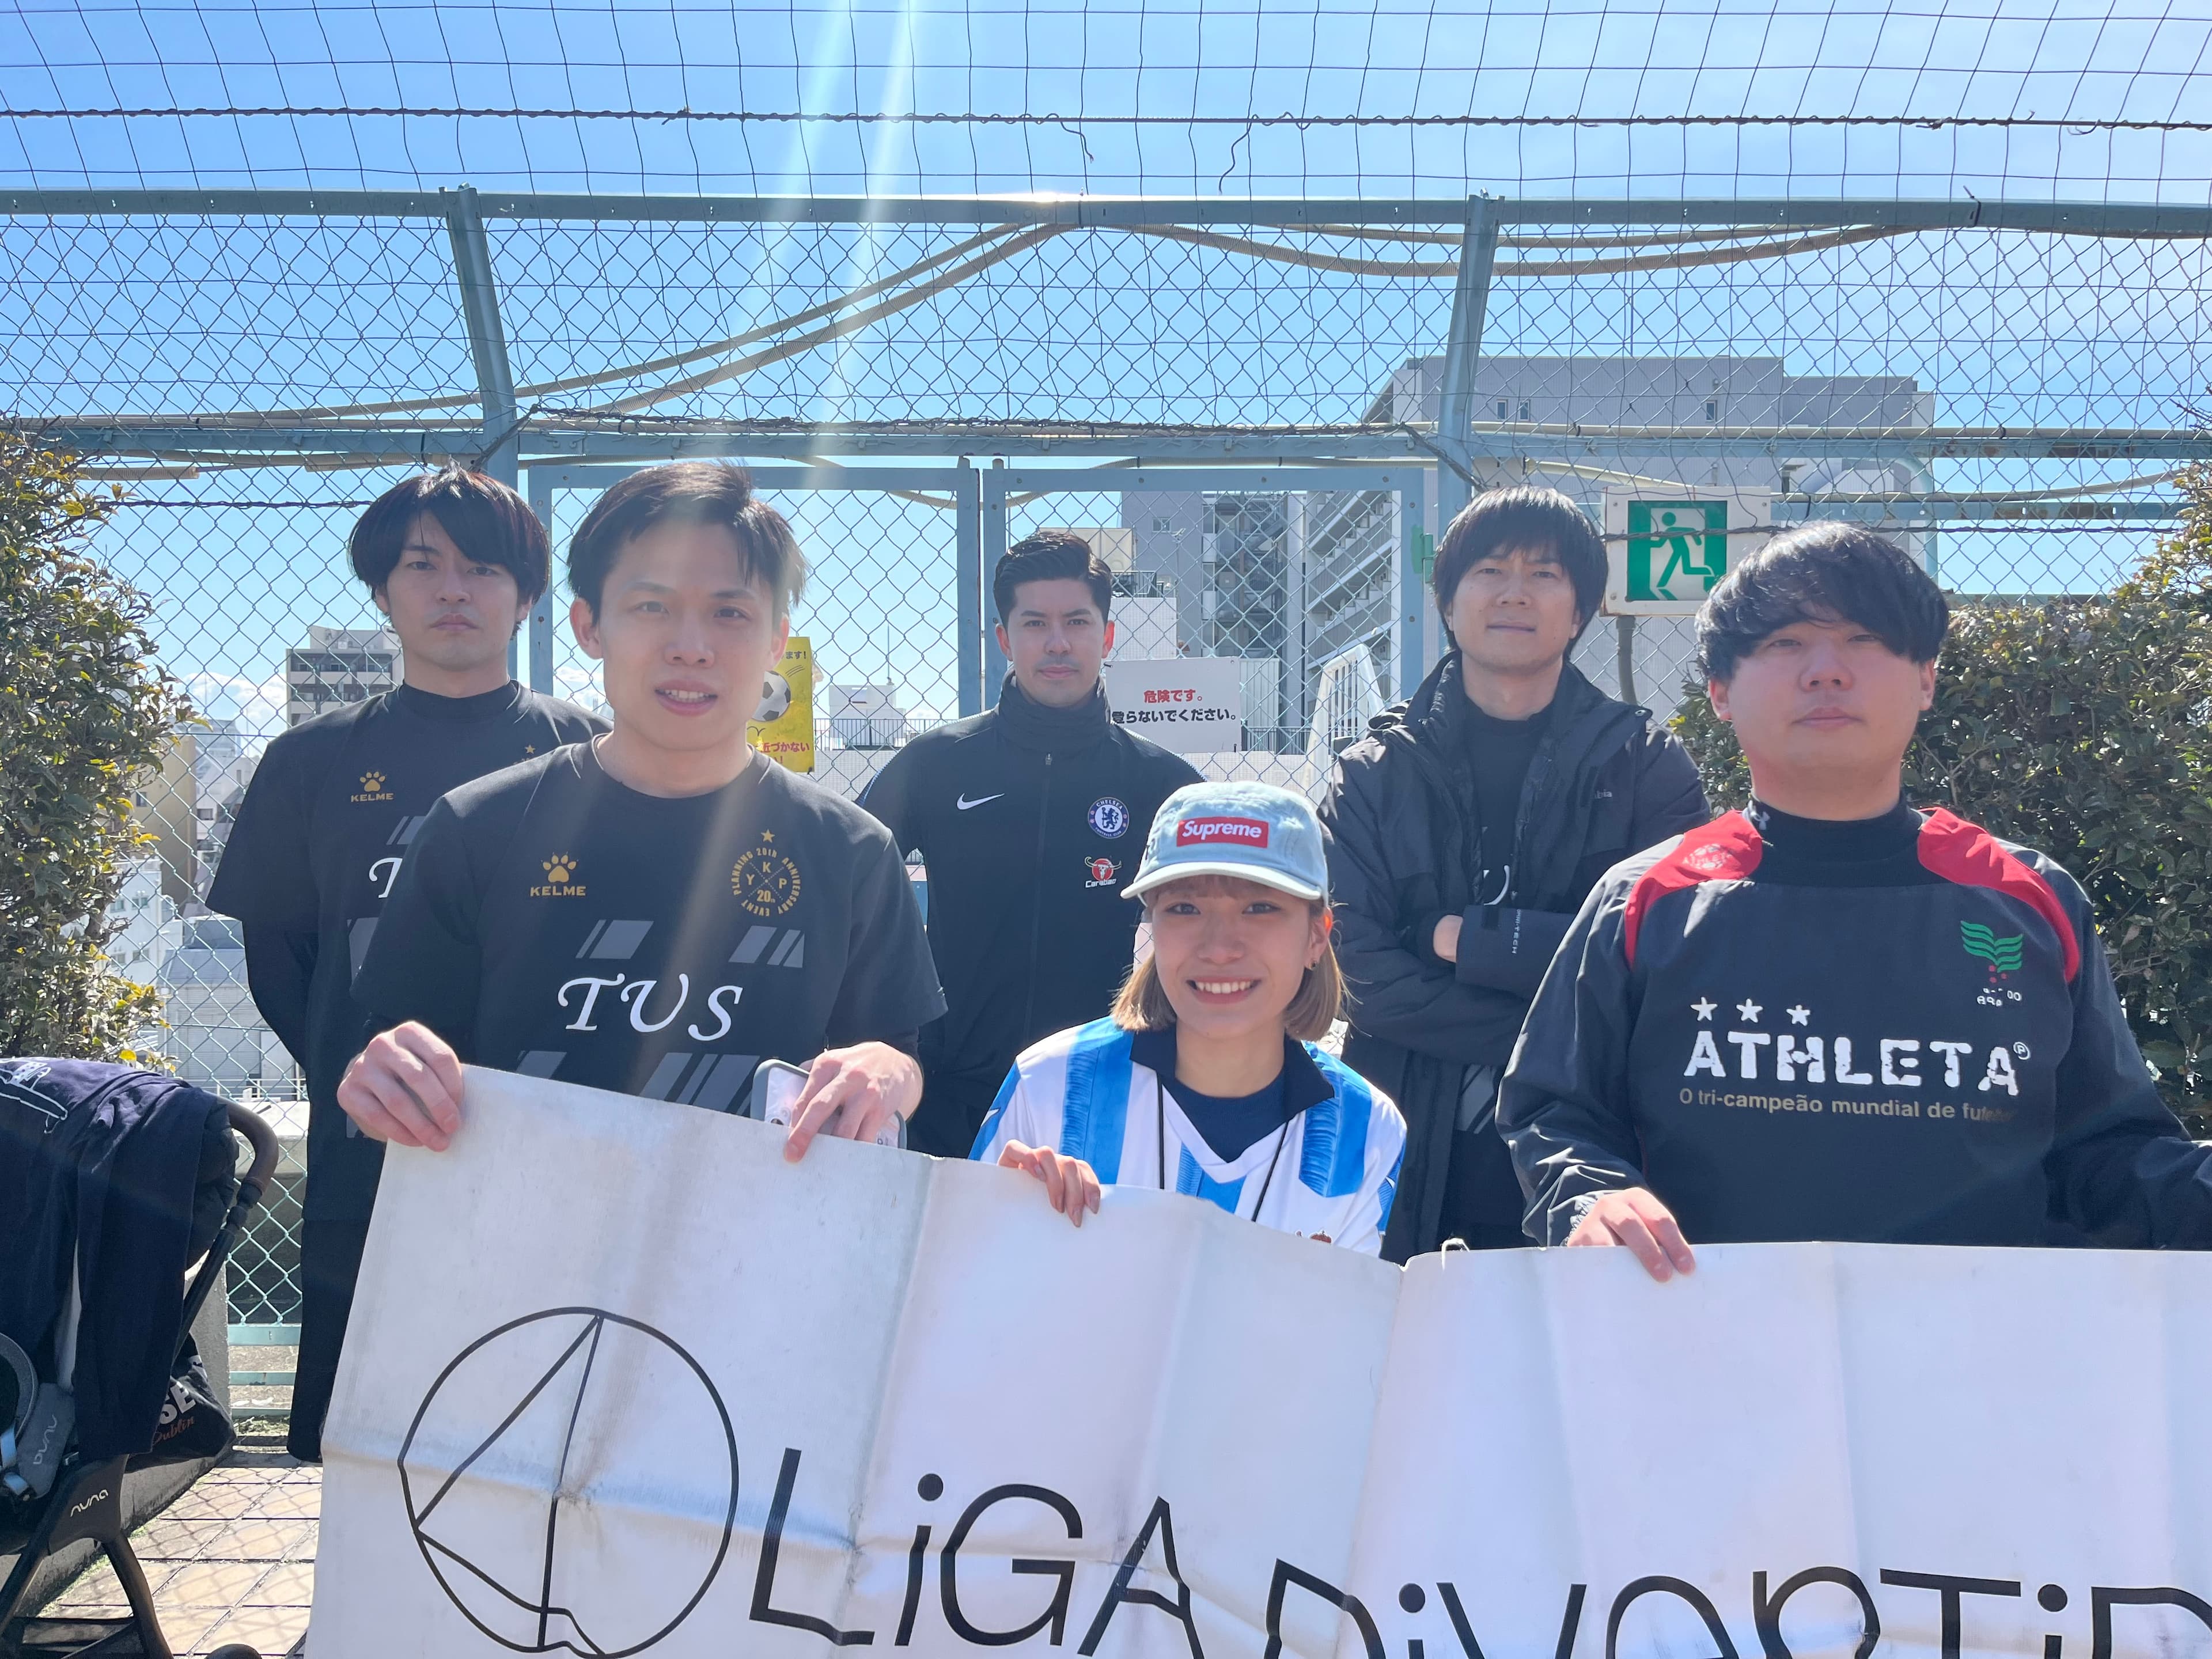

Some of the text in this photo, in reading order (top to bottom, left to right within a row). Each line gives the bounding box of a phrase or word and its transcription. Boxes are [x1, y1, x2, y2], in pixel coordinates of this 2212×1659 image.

[781, 650, 806, 660] ます!
[1143, 689, 1203, 703] 危険です。
[351, 793, 394, 802] KELME
[1096, 800, 1123, 810] CHELSEA
[1182, 820, 1262, 840] Supreme
[731, 851, 754, 896] PLANNING
[530, 885, 586, 897] KELME
[778, 857, 801, 914] ANNIVERSARY
[1085, 878, 1117, 888] Carabao
[741, 899, 770, 916] EVENT
[558, 973, 744, 1041] TUS
[1683, 1030, 2019, 1096] ATHLETA
[1679, 1088, 1692, 1104] O
[1698, 1089, 1823, 1113] tri-campeão
[1831, 1098, 1921, 1118] mundial
[1927, 1101, 1955, 1119] de
[70, 1488, 109, 1518] nuna
